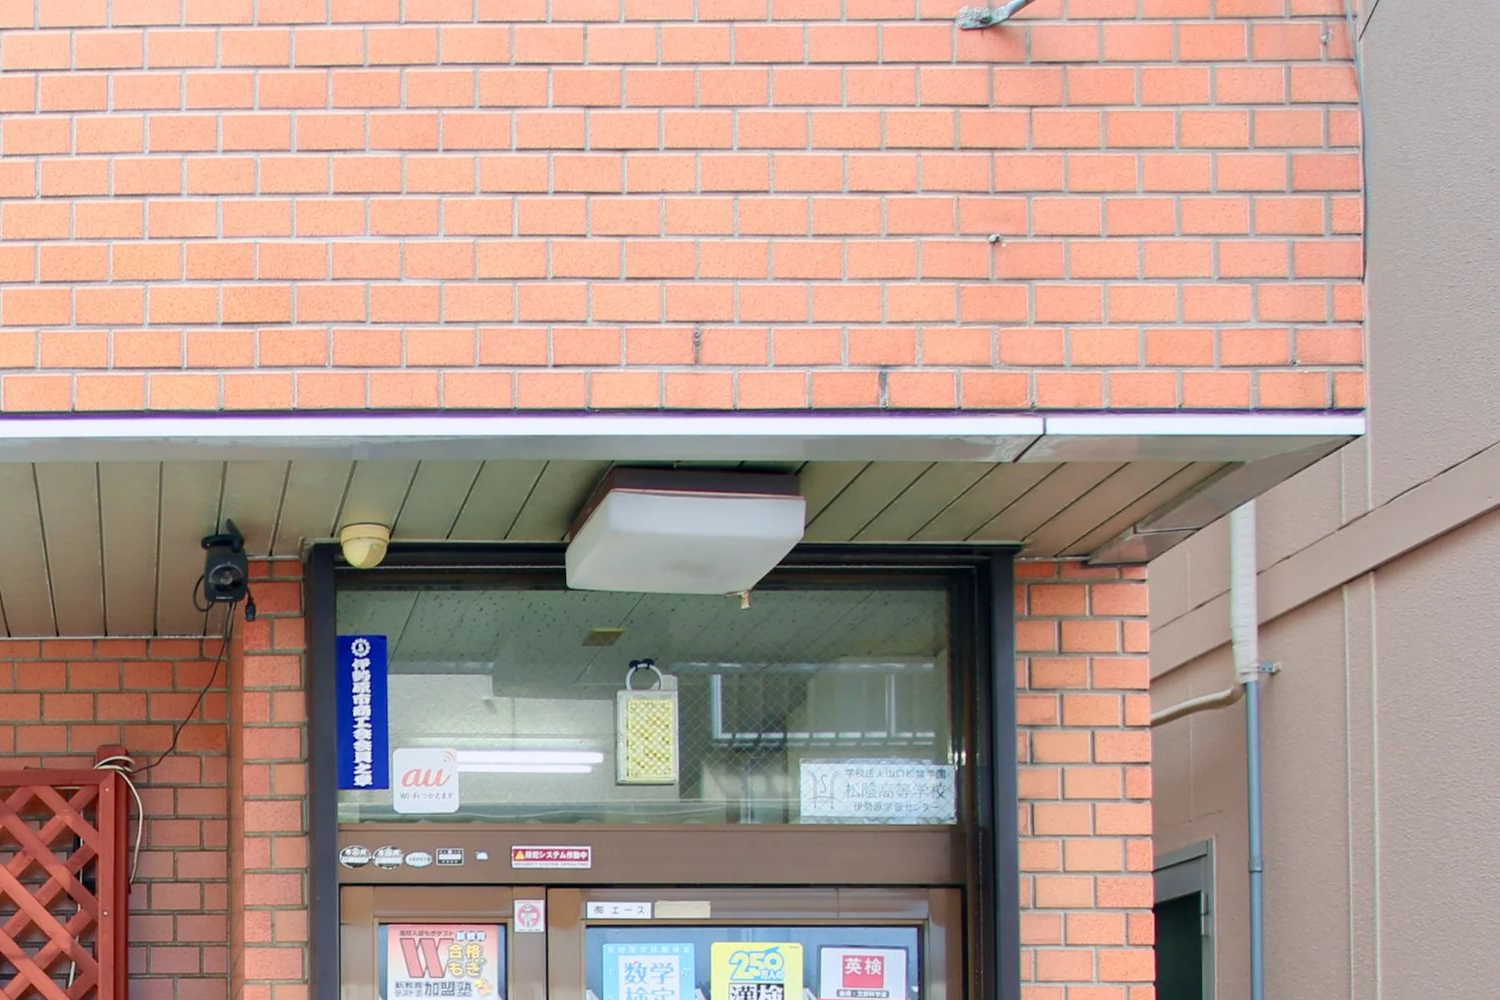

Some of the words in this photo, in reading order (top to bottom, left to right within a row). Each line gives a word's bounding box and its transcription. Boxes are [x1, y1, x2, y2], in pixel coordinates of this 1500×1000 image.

[401, 768, 452, 788] au
[612, 905, 645, 914] エース
[399, 937, 455, 979] W
[448, 944, 483, 959] 合格
[624, 961, 675, 984] 数学
[729, 946, 784, 981] 250
[844, 957, 883, 976] 英検
[425, 981, 471, 997] 加盟塾
